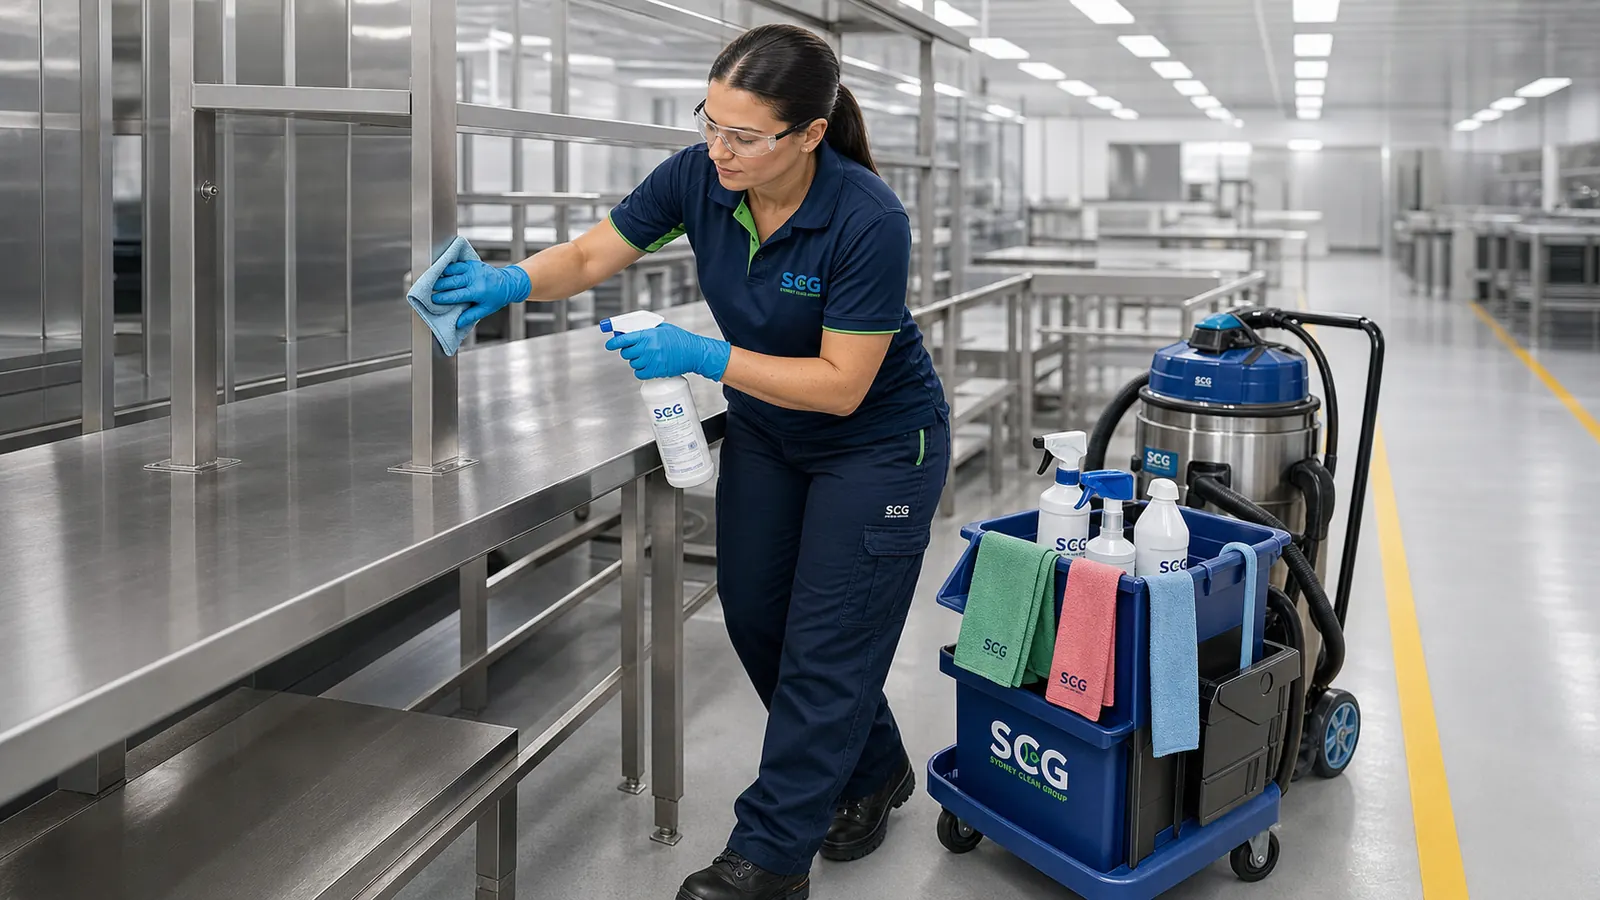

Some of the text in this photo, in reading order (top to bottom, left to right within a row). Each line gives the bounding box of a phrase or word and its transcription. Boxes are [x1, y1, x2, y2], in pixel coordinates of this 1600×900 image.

[781, 271, 821, 293] SCG
[1195, 376, 1212, 385] SCG
[653, 403, 684, 419] SCG
[1147, 451, 1170, 467] SCG
[885, 505, 910, 515] SCG
[982, 638, 1008, 658] SCG
[1060, 671, 1087, 692] SCG
[990, 720, 1069, 791] SCG
[1018, 771, 1041, 790] CLEAN
[1042, 784, 1068, 802] GROUP
